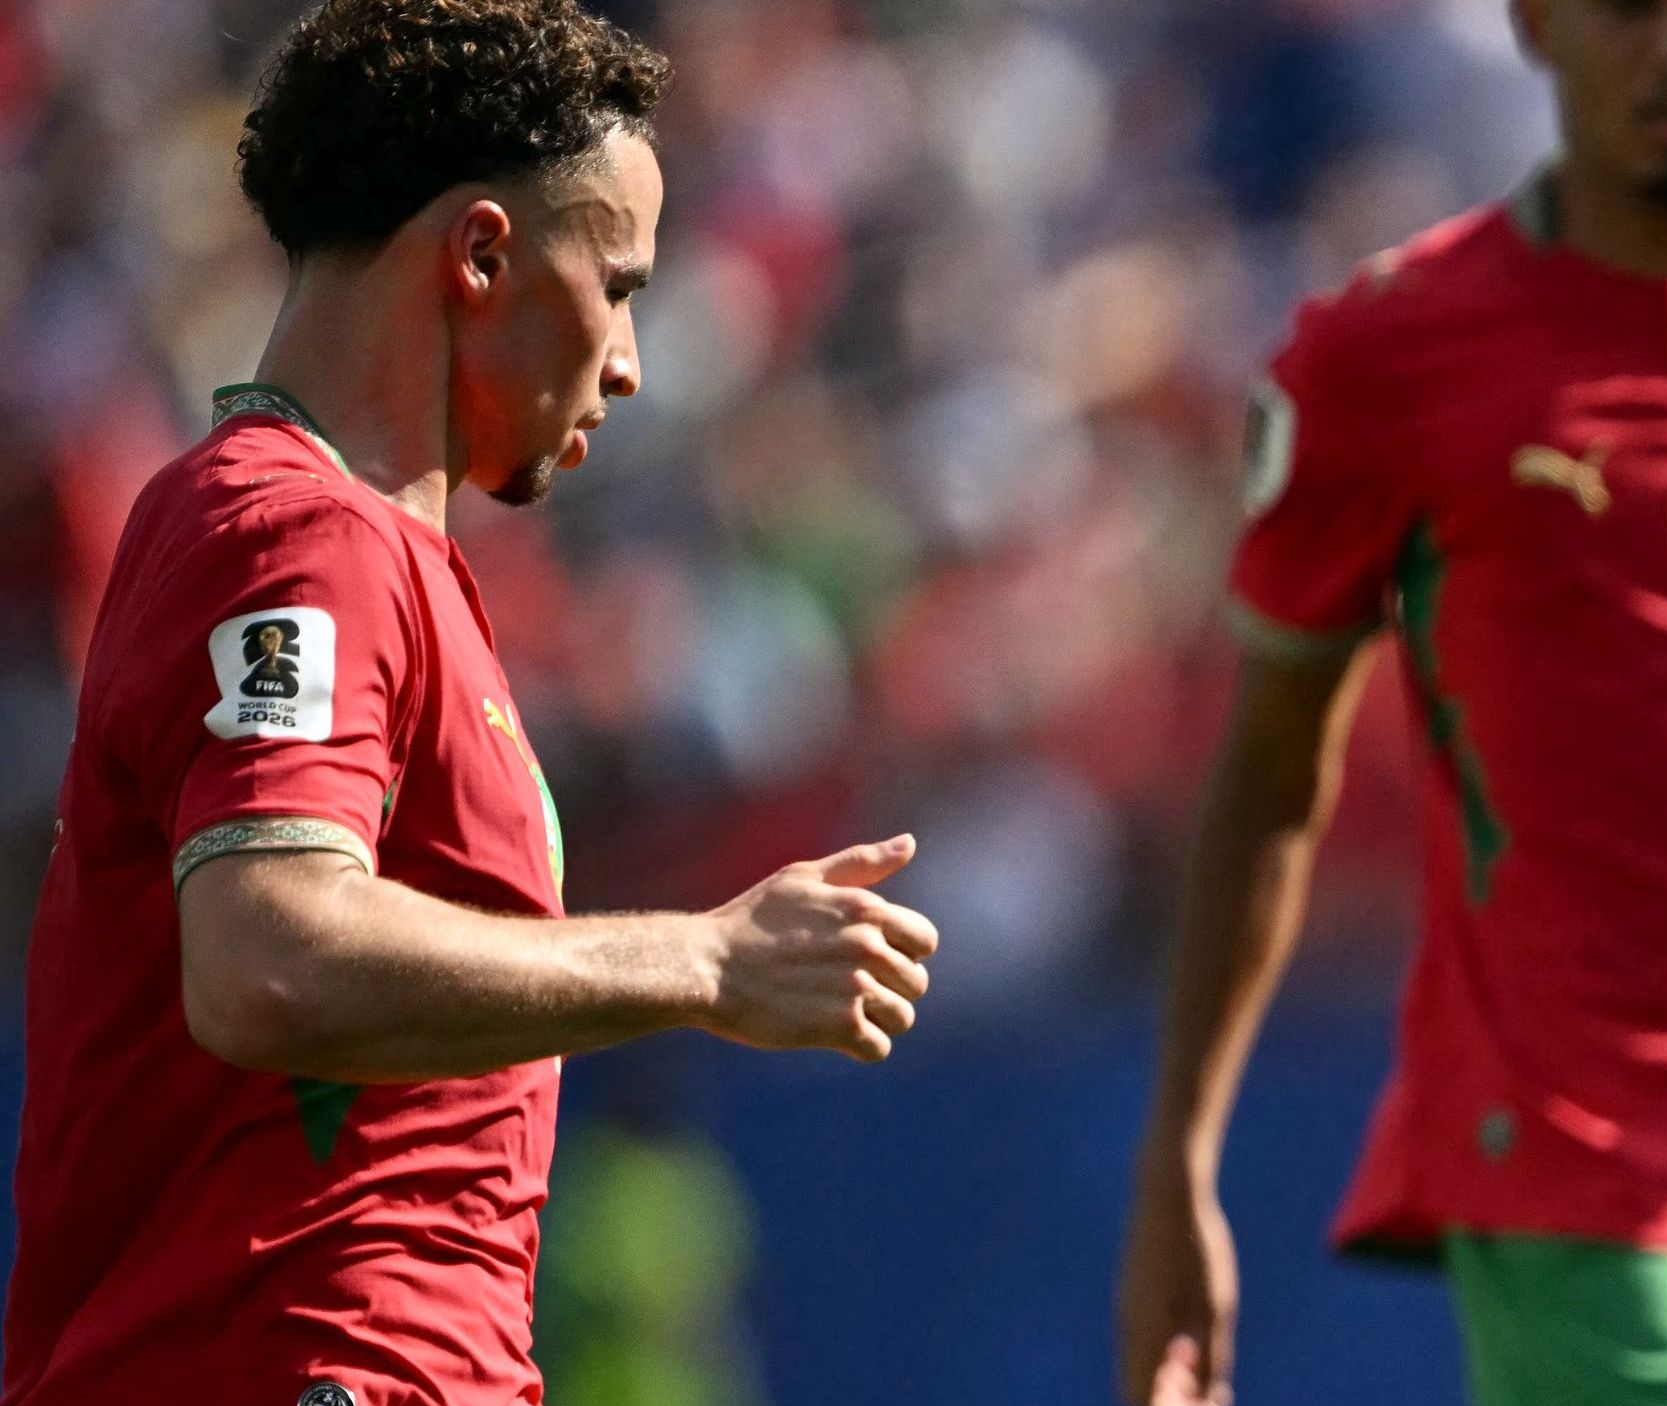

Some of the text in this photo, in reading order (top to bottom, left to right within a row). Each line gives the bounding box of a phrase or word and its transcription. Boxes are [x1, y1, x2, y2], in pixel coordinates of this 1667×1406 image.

[256, 680, 284, 692] FIFA
[238, 702, 297, 713] WORLD CUP
[237, 711, 296, 728] 2026
